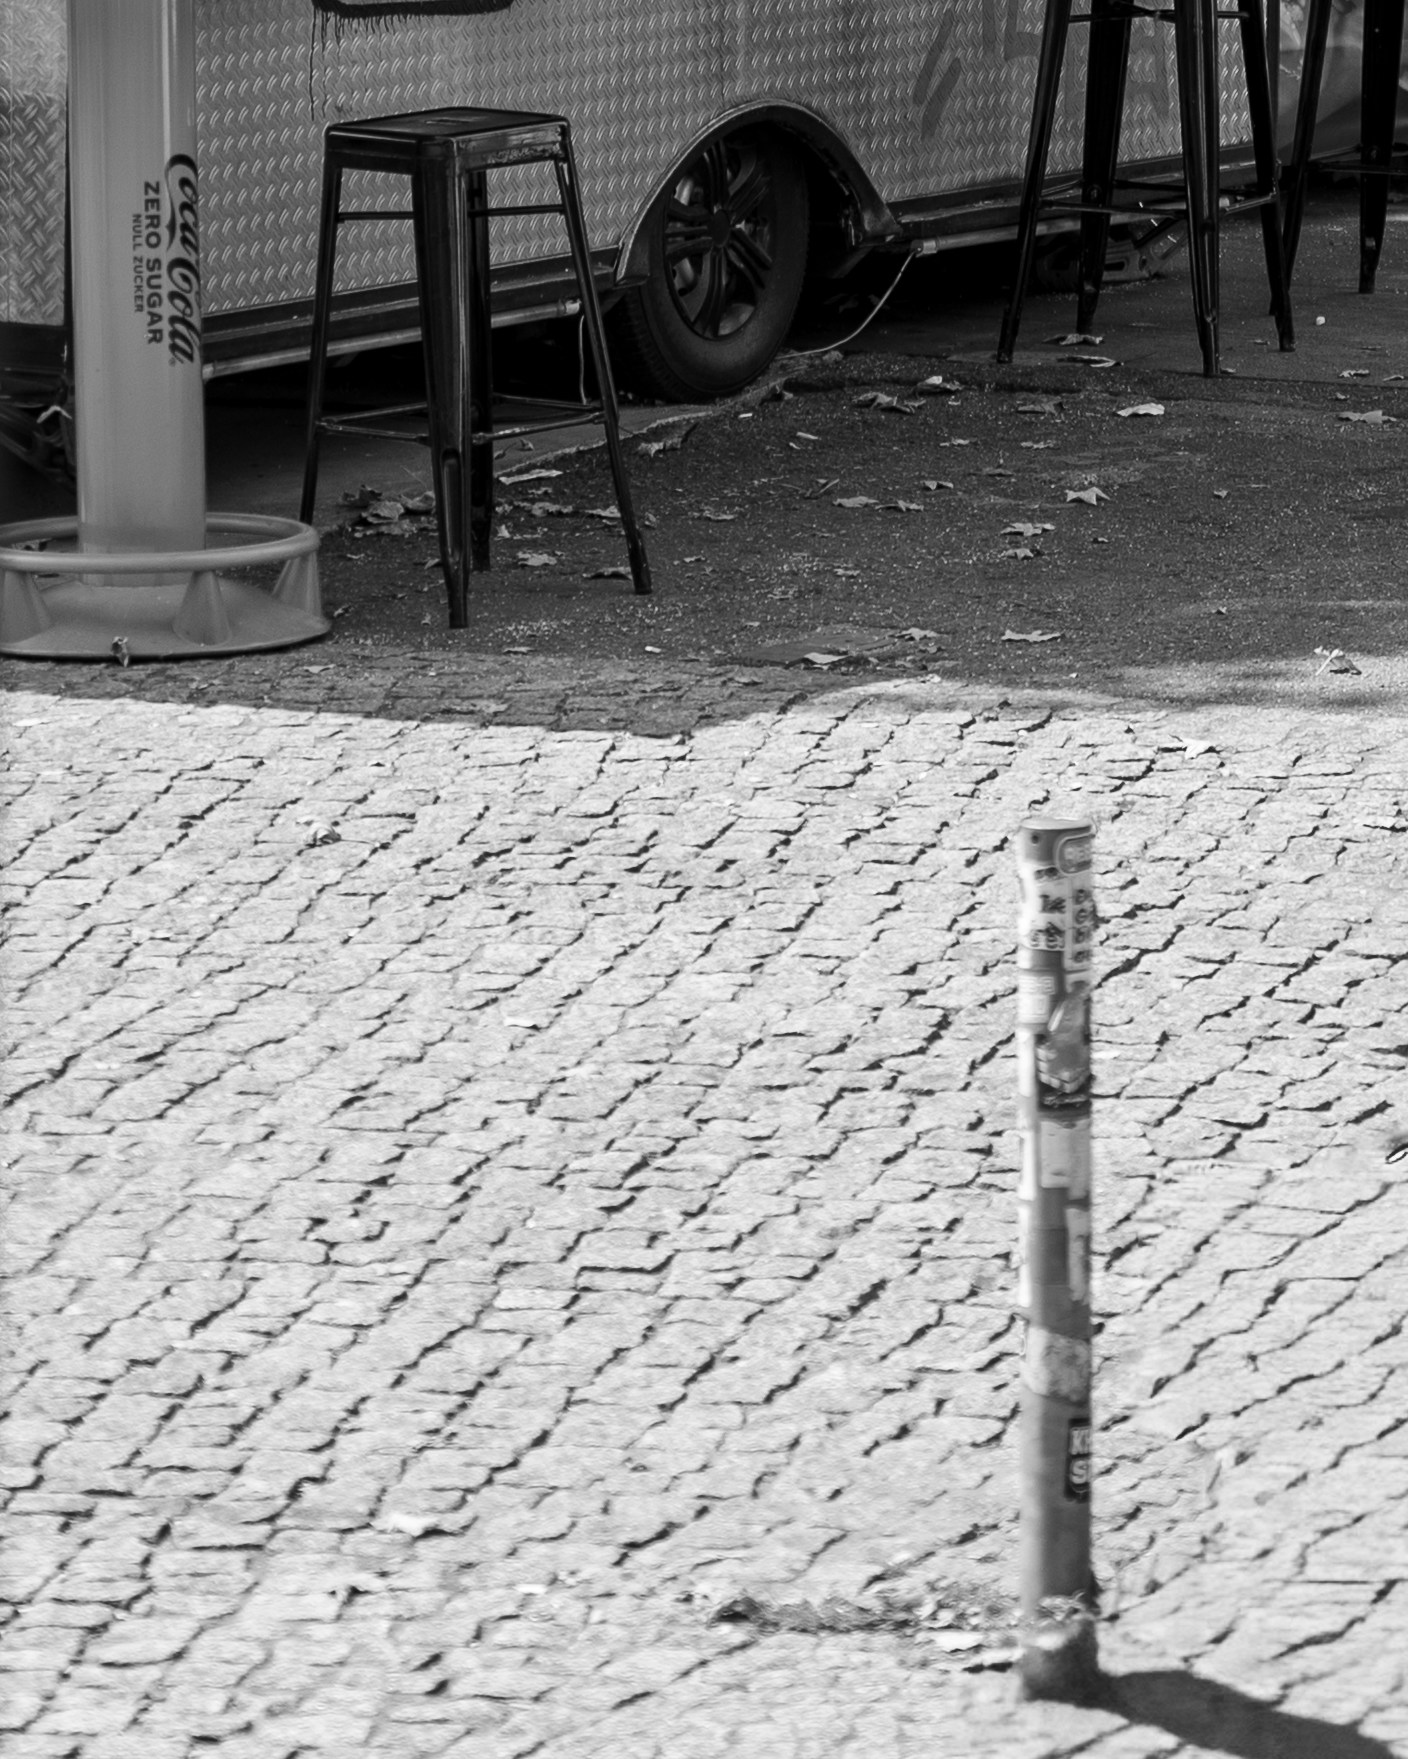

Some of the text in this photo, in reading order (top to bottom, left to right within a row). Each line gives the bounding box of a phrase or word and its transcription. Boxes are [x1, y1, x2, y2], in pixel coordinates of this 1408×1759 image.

[132, 213, 144, 314] NULL ZUCKER
[144, 181, 164, 344] ZERO SUGAR
